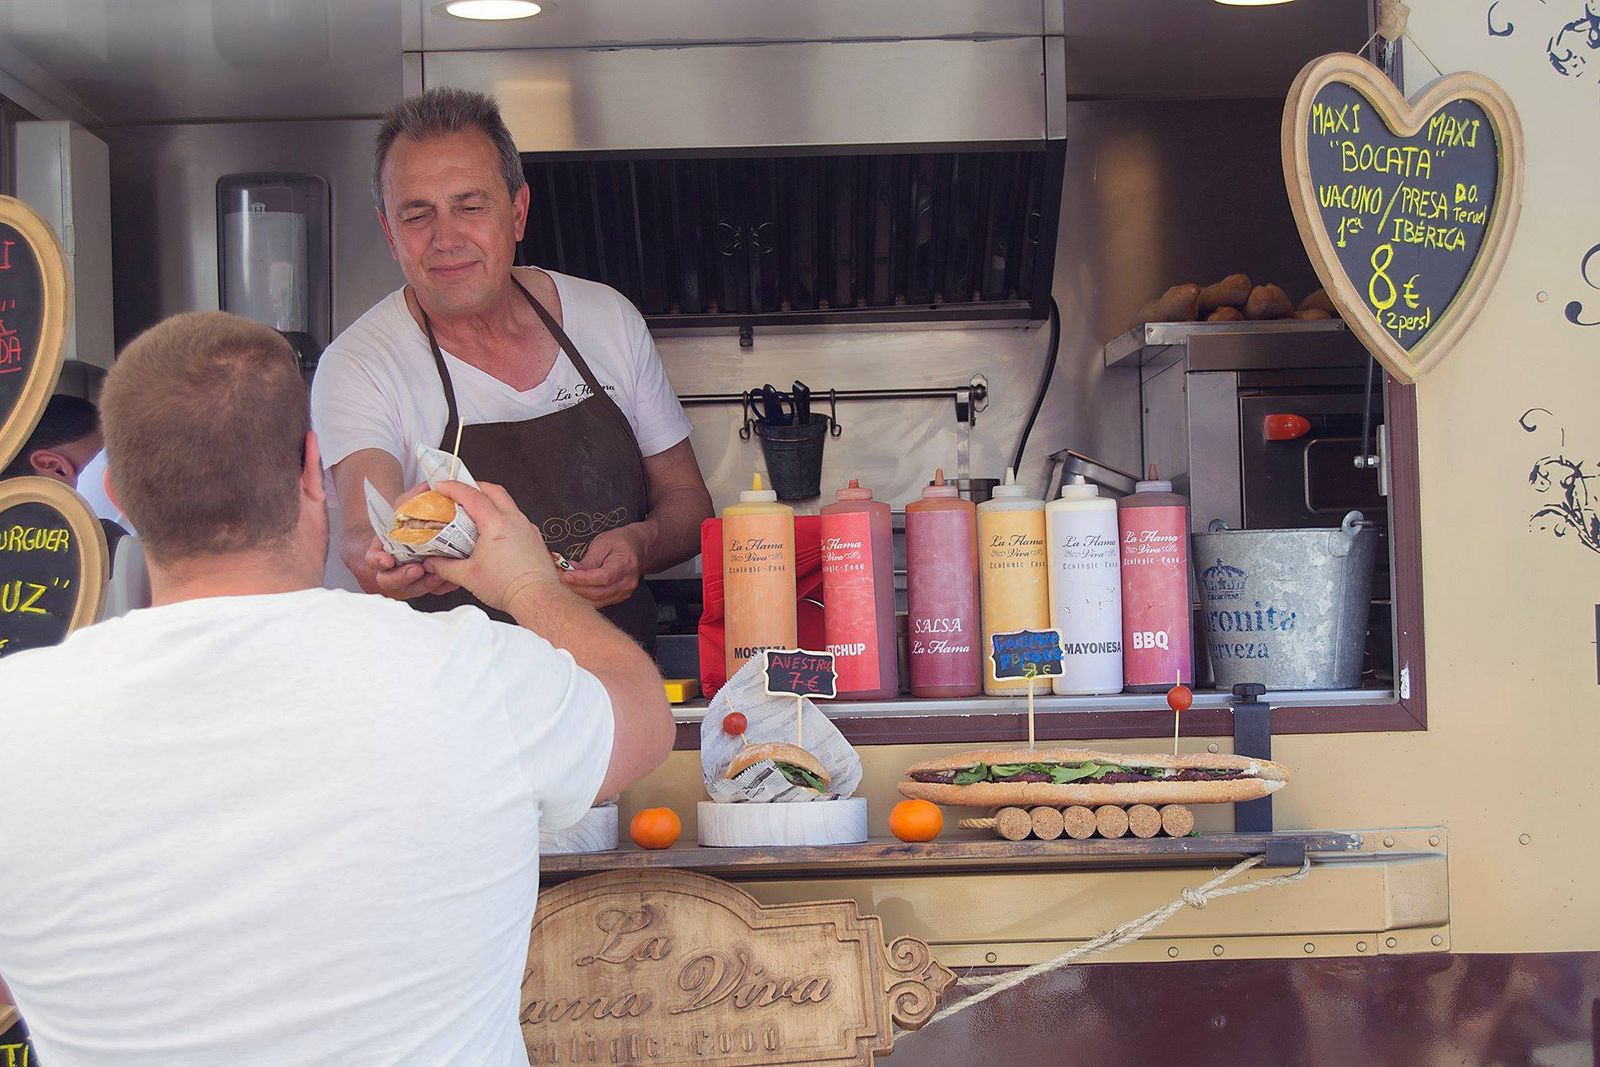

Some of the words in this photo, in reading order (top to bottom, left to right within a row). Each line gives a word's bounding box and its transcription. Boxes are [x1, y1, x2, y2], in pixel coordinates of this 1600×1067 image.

[1312, 103, 1360, 135] MAXI
[1428, 112, 1480, 148] MAXI
[1319, 185, 1382, 215] VACUNO
[1401, 186, 1448, 221] PRESA
[552, 386, 572, 402] La
[990, 535, 1005, 547] La
[1063, 535, 1079, 548] La
[1124, 531, 1137, 544] La
[730, 540, 743, 552] La
[1136, 543, 1161, 554] Viva
[1006, 549, 1030, 559] Viva
[915, 617, 963, 634] SALSA
[912, 640, 925, 654] La
[927, 640, 970, 654] Flama
[1065, 641, 1121, 655] MAYONESA
[1133, 631, 1168, 650] BBQ
[575, 908, 671, 966] La
[669, 952, 830, 1015] Viva
